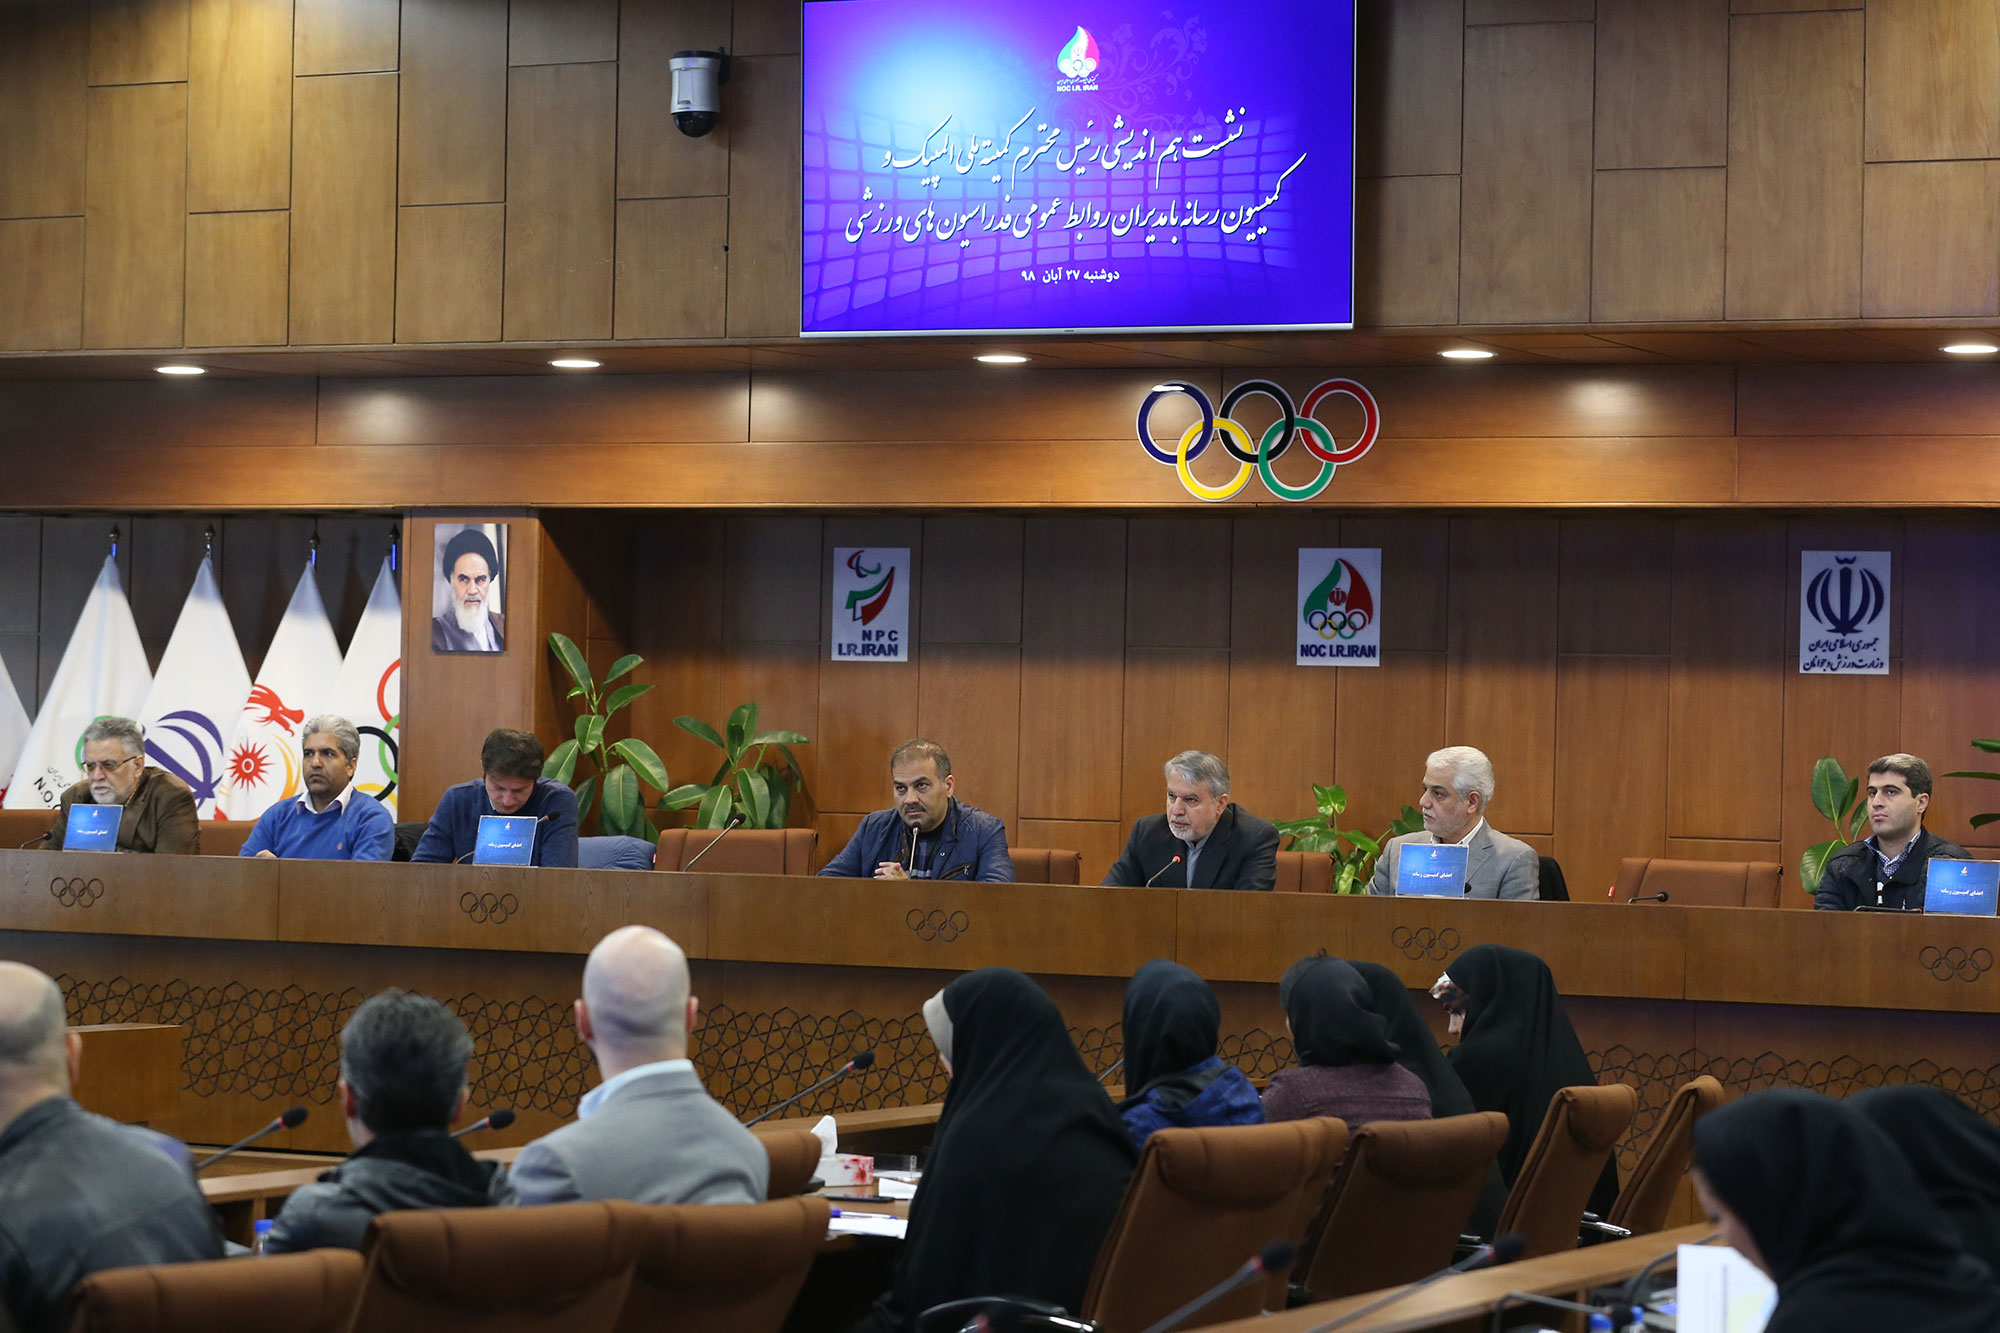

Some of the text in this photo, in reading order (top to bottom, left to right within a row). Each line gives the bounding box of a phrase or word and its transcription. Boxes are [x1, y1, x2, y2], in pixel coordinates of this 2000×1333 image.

[892, 113, 955, 188] المپیک
[955, 133, 979, 174] ملی
[979, 106, 1036, 183] کمیته
[1101, 114, 1156, 170] اندیشی
[1182, 106, 1246, 159] نشست
[881, 150, 892, 168] و
[1011, 122, 1061, 191] محترم
[1155, 136, 1183, 190] هم
[845, 186, 903, 243] ورزشی
[1012, 197, 1062, 239] عمومی
[1180, 200, 1220, 229] رسانه
[1220, 152, 1307, 242] کمیسیون
[903, 200, 936, 242] های
[935, 194, 1012, 248] فدراسیون
[1063, 201, 1110, 241] روابط
[1021, 266, 1120, 284] دوشنبه ۲۷ آبان ۹۸
[1300, 644, 1326, 657] NOC
[1803, 655, 1827, 671] جوانان
[1808, 637, 1879, 653] جمهوری اسلامی ایران
[1830, 654, 1855, 671] ورزش
[1854, 658, 1884, 669] وزارت
